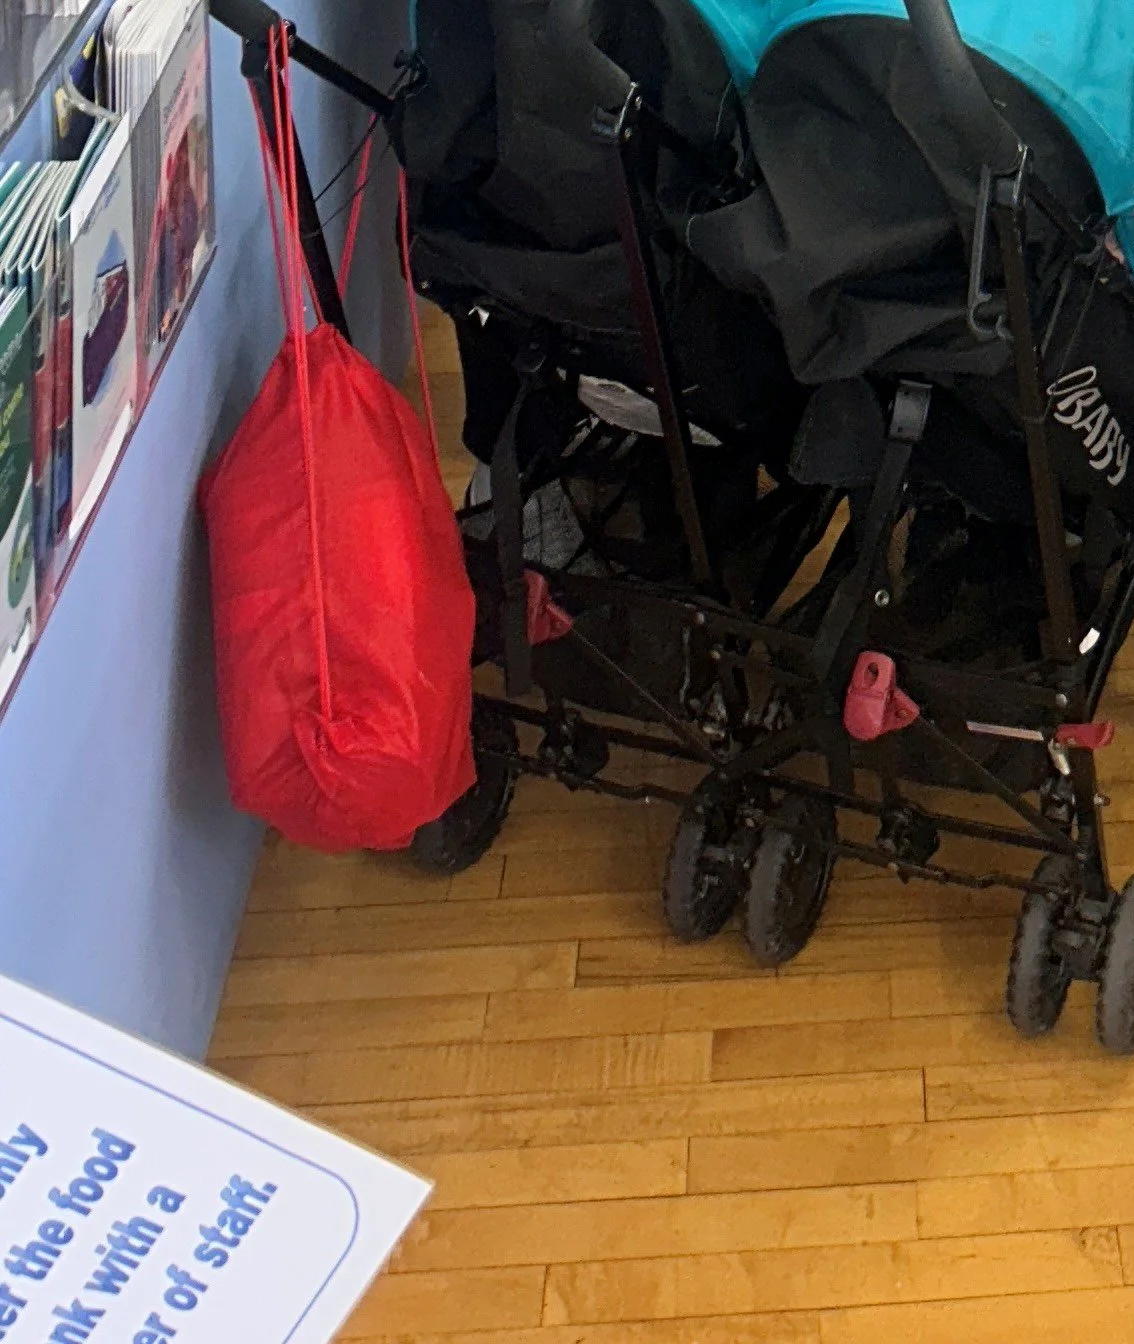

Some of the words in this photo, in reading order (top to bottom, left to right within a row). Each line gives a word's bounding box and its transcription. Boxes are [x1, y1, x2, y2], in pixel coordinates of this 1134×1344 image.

[4, 1219, 74, 1280] the
[48, 1127, 136, 1217] food
[44, 1298, 106, 1344] nk
[84, 1216, 164, 1295] with
[147, 1185, 186, 1213] a
[133, 1312, 177, 1344] er
[163, 1263, 209, 1312] of
[193, 1173, 279, 1268] staff.
